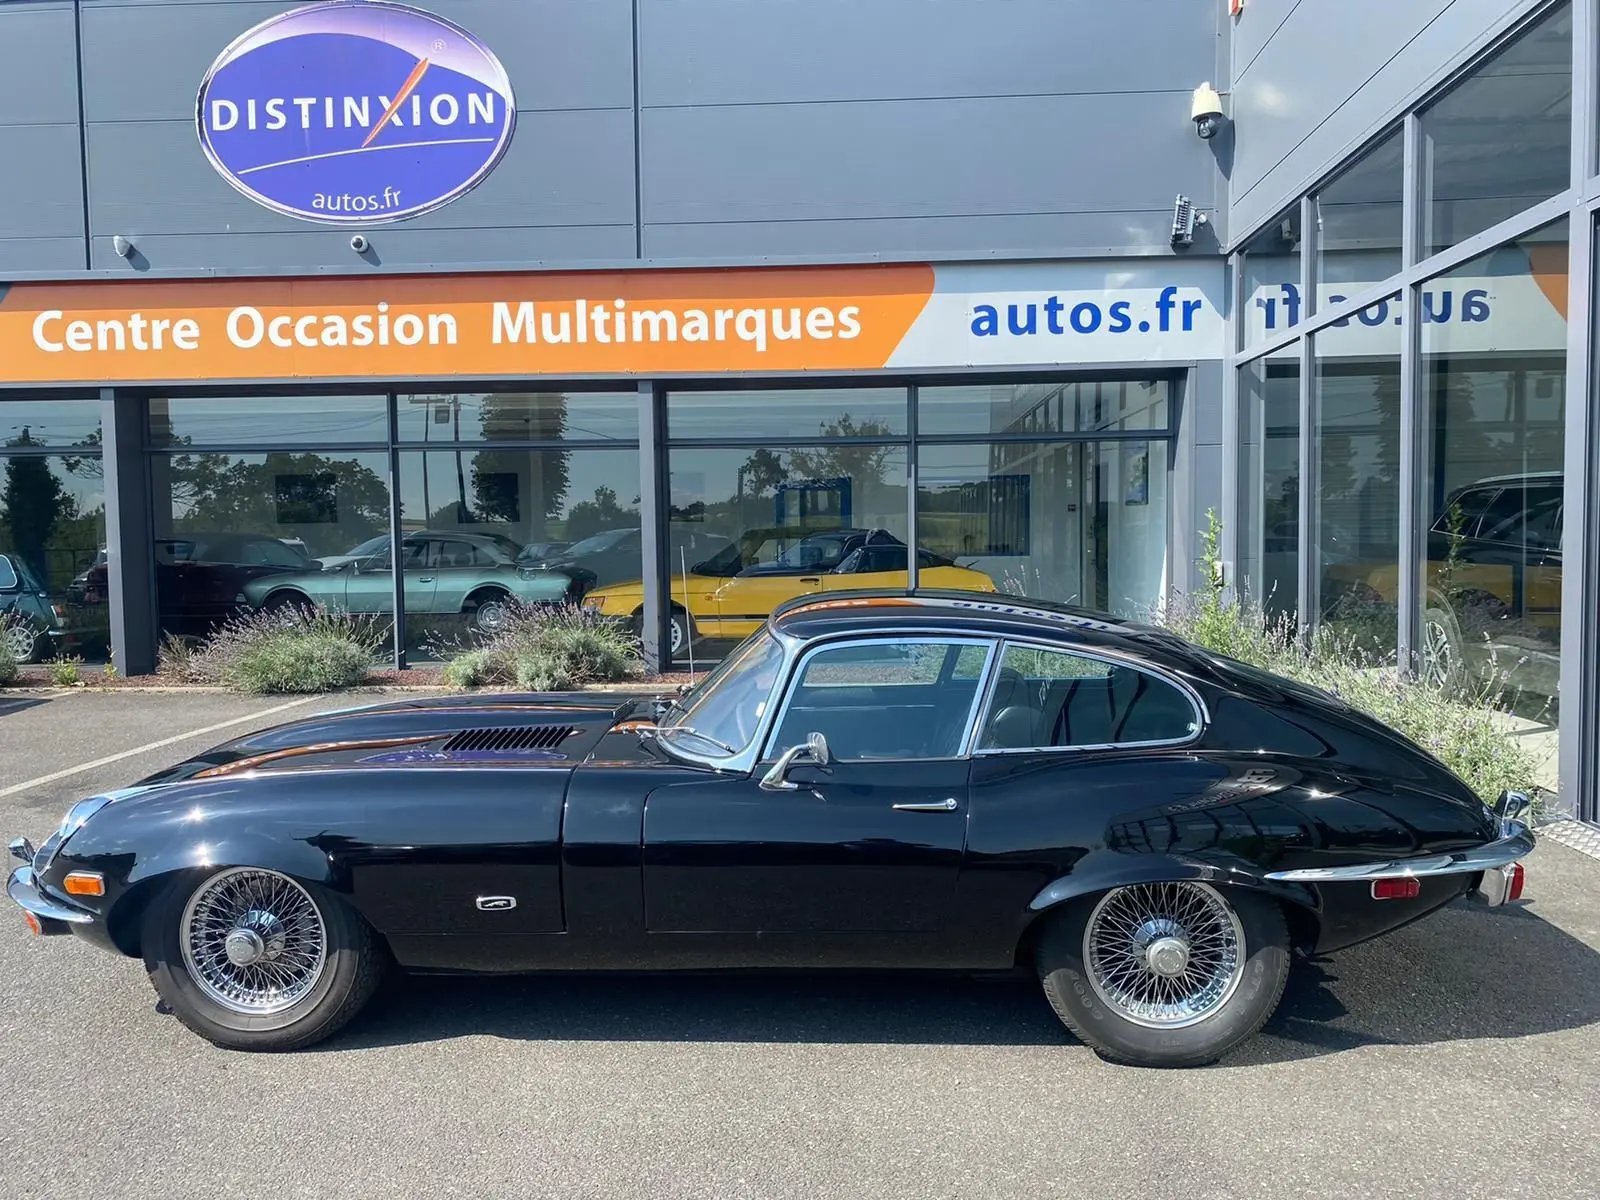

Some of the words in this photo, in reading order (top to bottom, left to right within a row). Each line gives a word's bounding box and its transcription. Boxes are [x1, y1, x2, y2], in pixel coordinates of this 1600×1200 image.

[212, 92, 494, 131] DISTINXION
[312, 186, 402, 212] autos.fr
[32, 310, 200, 352] Centre
[226, 302, 457, 349] Occasion
[492, 299, 861, 352] Multimarques
[971, 287, 1202, 337] autos.fr
